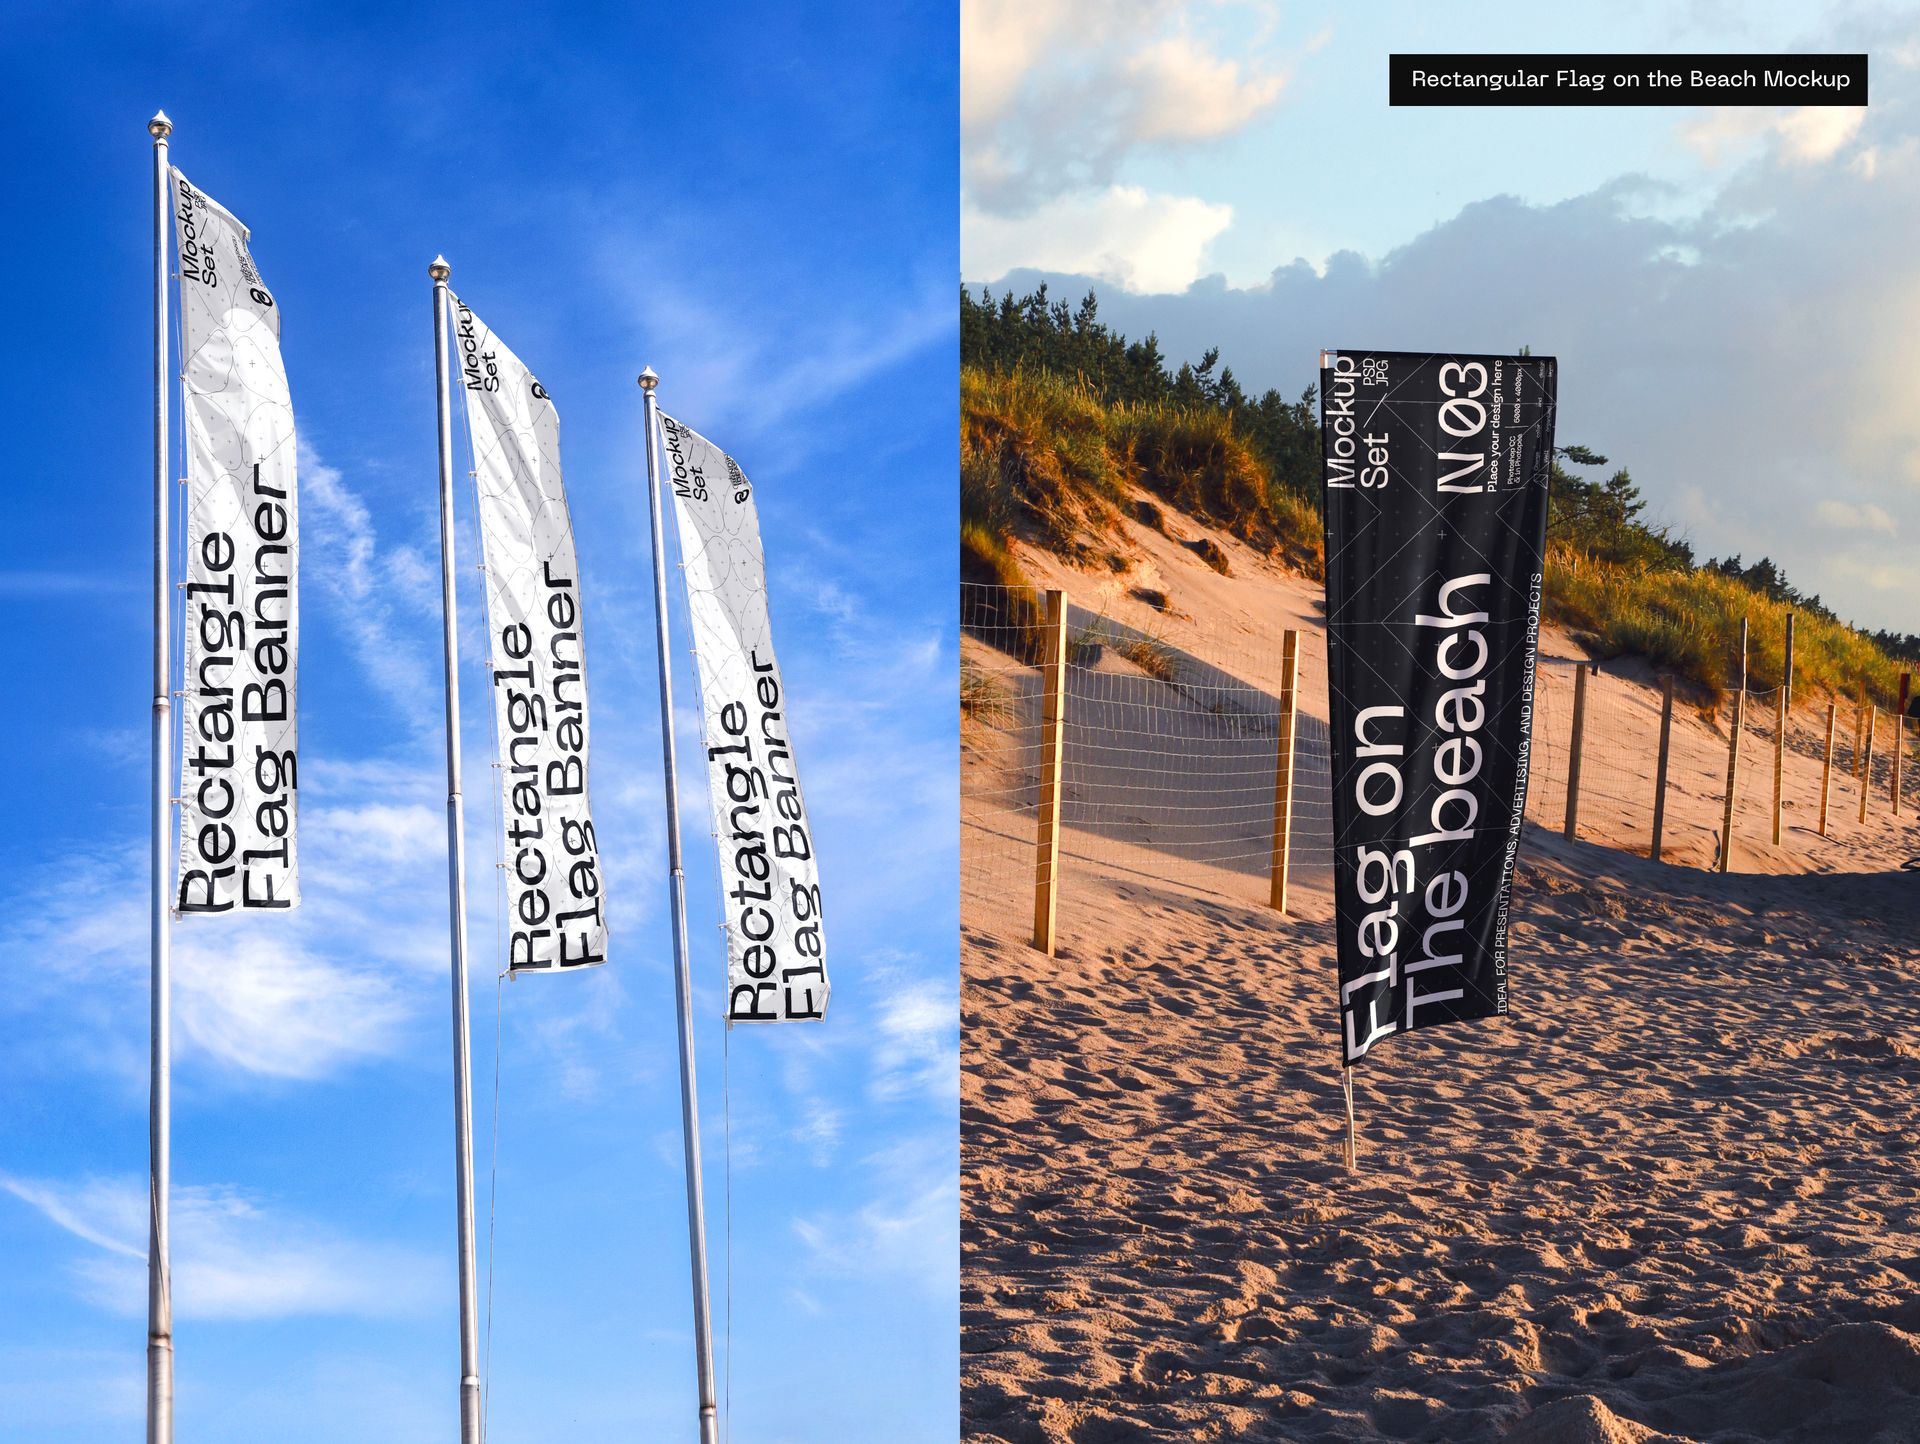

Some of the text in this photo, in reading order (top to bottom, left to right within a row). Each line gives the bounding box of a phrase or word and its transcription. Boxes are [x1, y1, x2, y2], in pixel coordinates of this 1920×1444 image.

[178, 180, 200, 282] Mockup
[200, 243, 217, 288] Set
[482, 351, 499, 393] Set
[1325, 356, 1362, 489] Mockup
[1363, 358, 1375, 386] PSD
[1376, 360, 1389, 387] JPG
[1487, 360, 1503, 492] Place your design here
[664, 418, 691, 498] Mockup
[690, 466, 708, 502] Set
[1360, 432, 1389, 489] Set
[1507, 435, 1517, 485] Photoshop CC
[178, 531, 245, 913] Rectangle
[241, 463, 298, 910] Flag Banner
[494, 622, 552, 971] Rectangle
[543, 561, 604, 968] Flag Banner
[1404, 573, 1491, 1029] The beach
[1495, 573, 1542, 1015] IDEAL FOR PRESENTATIONS, ADVERTISING, AND DESIGN PROJECTS
[709, 700, 777, 1021] Rectangle
[751, 650, 825, 1019] Flag Banner
[1341, 705, 1415, 1062] Flag on
